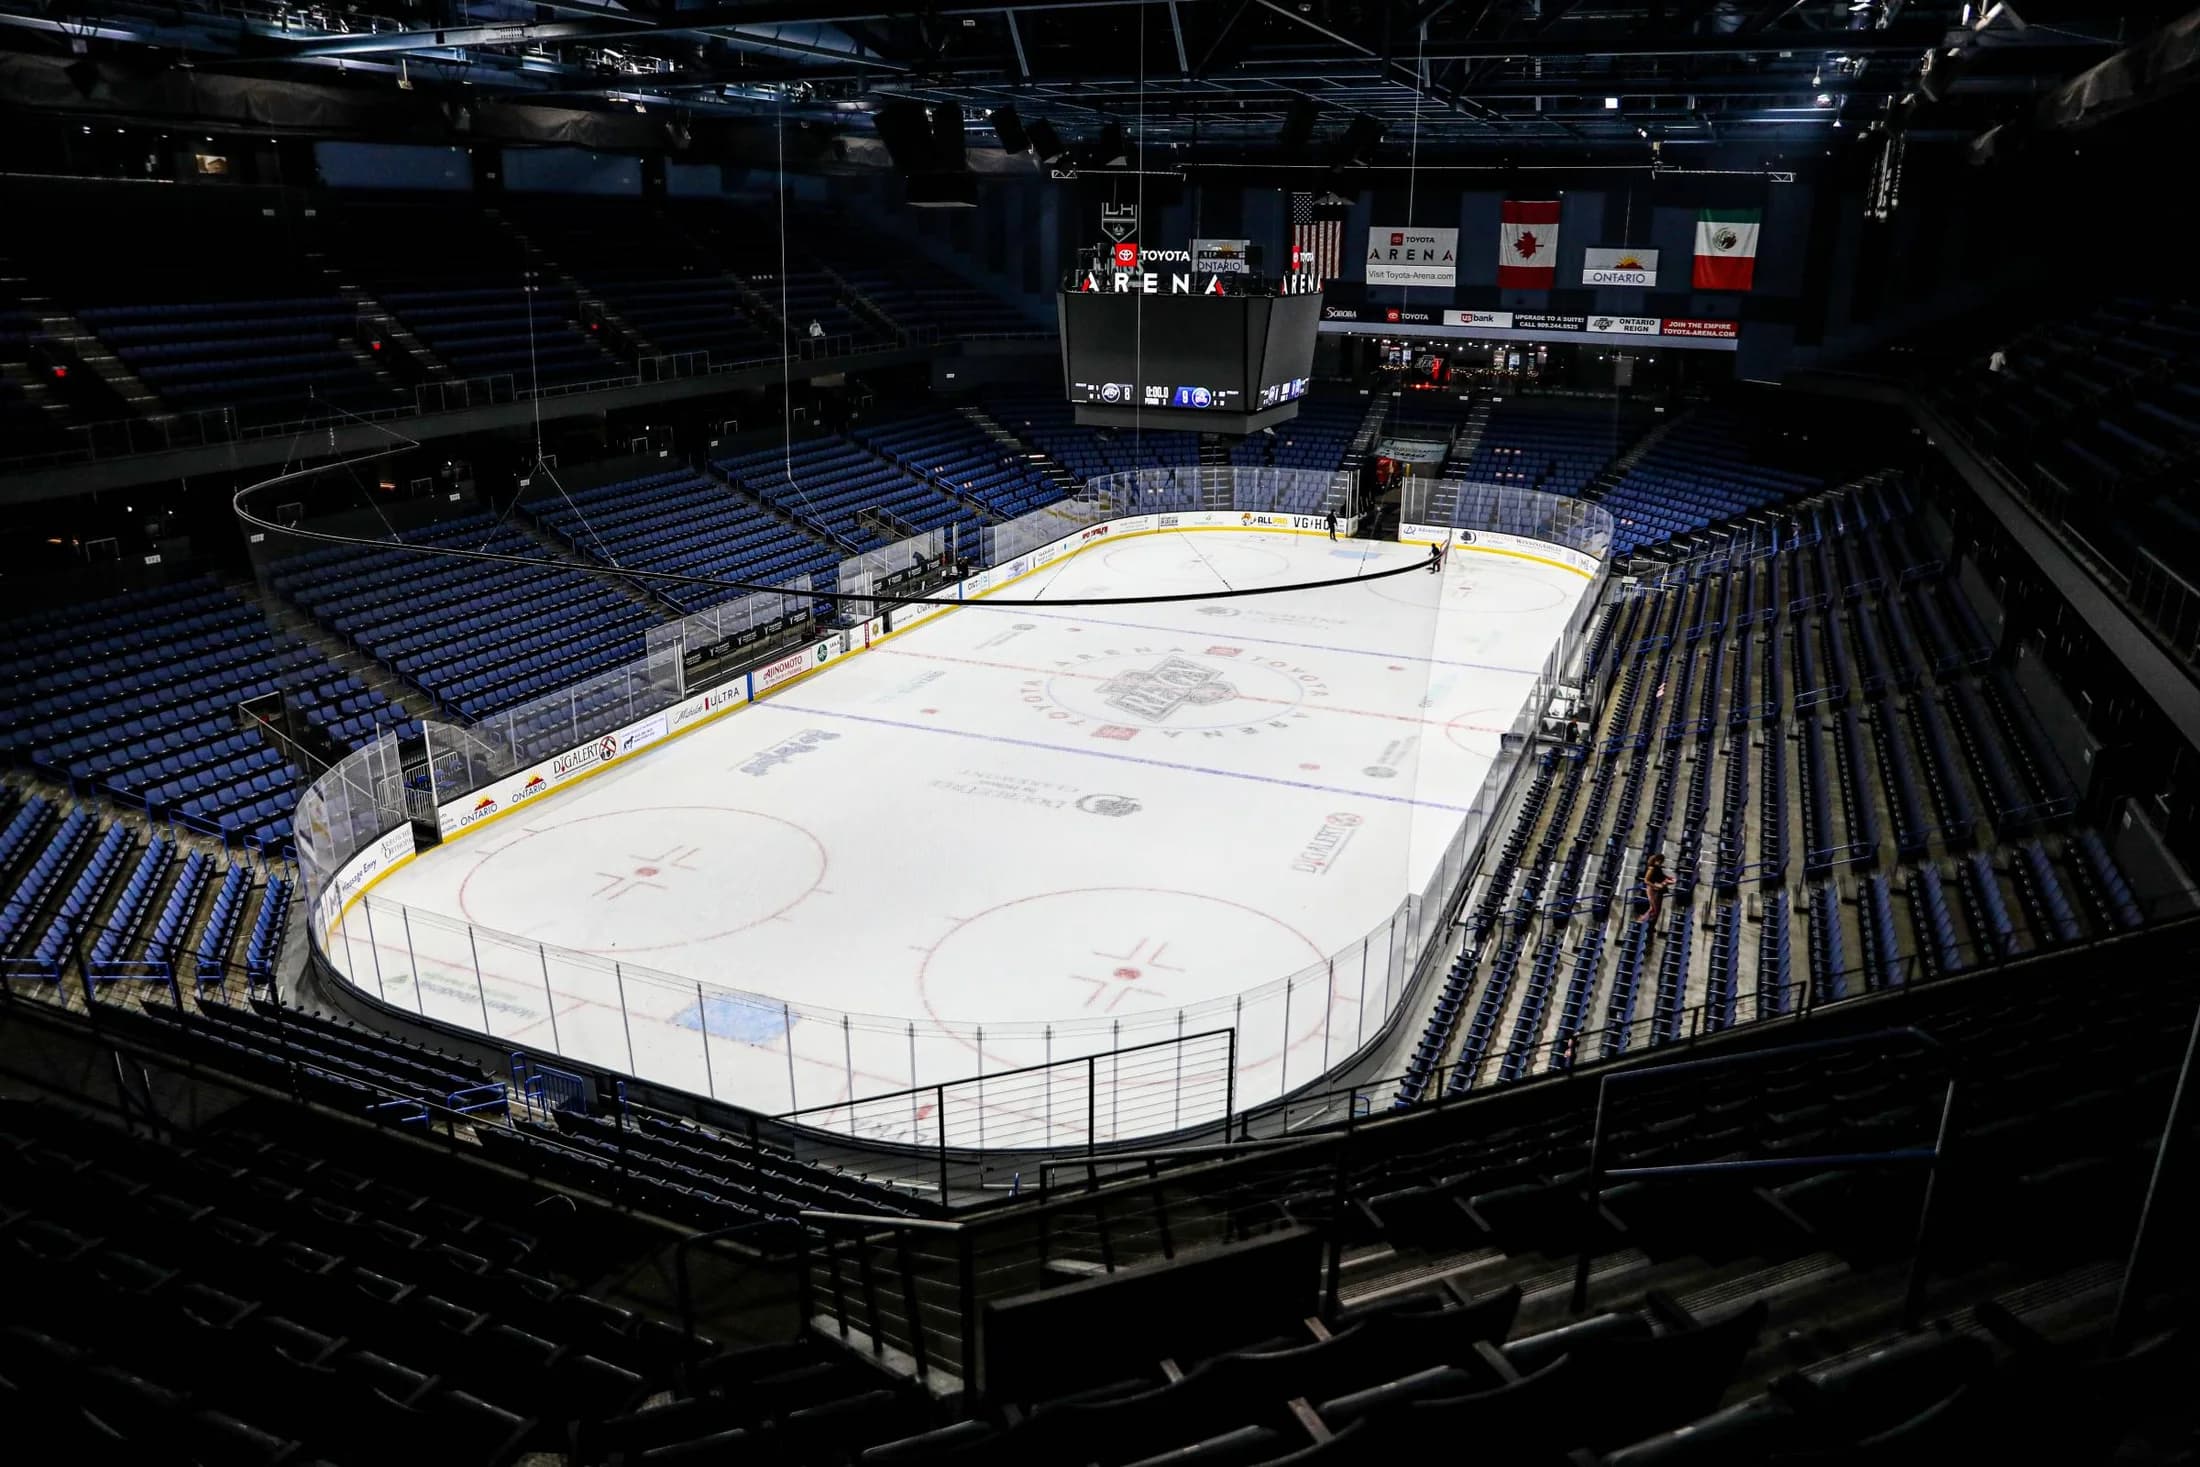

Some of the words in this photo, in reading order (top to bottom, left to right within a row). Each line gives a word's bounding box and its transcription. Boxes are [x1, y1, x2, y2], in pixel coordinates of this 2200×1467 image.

[1406, 236, 1435, 244] TOYOTA
[1142, 250, 1191, 262] TOYOTA
[1368, 248, 1454, 261] ARENA
[1368, 270, 1385, 278] Visit
[1386, 271, 1454, 280] Toyota-Arena.com
[1593, 272, 1645, 285] ONTARIO
[1081, 272, 1225, 296] ARENA
[1281, 273, 1324, 296] ARENA
[1401, 312, 1429, 321] TOYOTA
[1619, 318, 1655, 327] ONTARIO
[1624, 325, 1649, 333] REIGN
[1703, 322, 1731, 330] EMPIRE
[1663, 329, 1736, 337] TOYOTA-ARENA.COM
[763, 656, 803, 680] AJINOMOTO
[710, 687, 740, 706] ULTRA
[553, 742, 600, 774] DIGALERT
[511, 781, 548, 803] ONTARIO
[460, 803, 498, 826] ONTARIO
